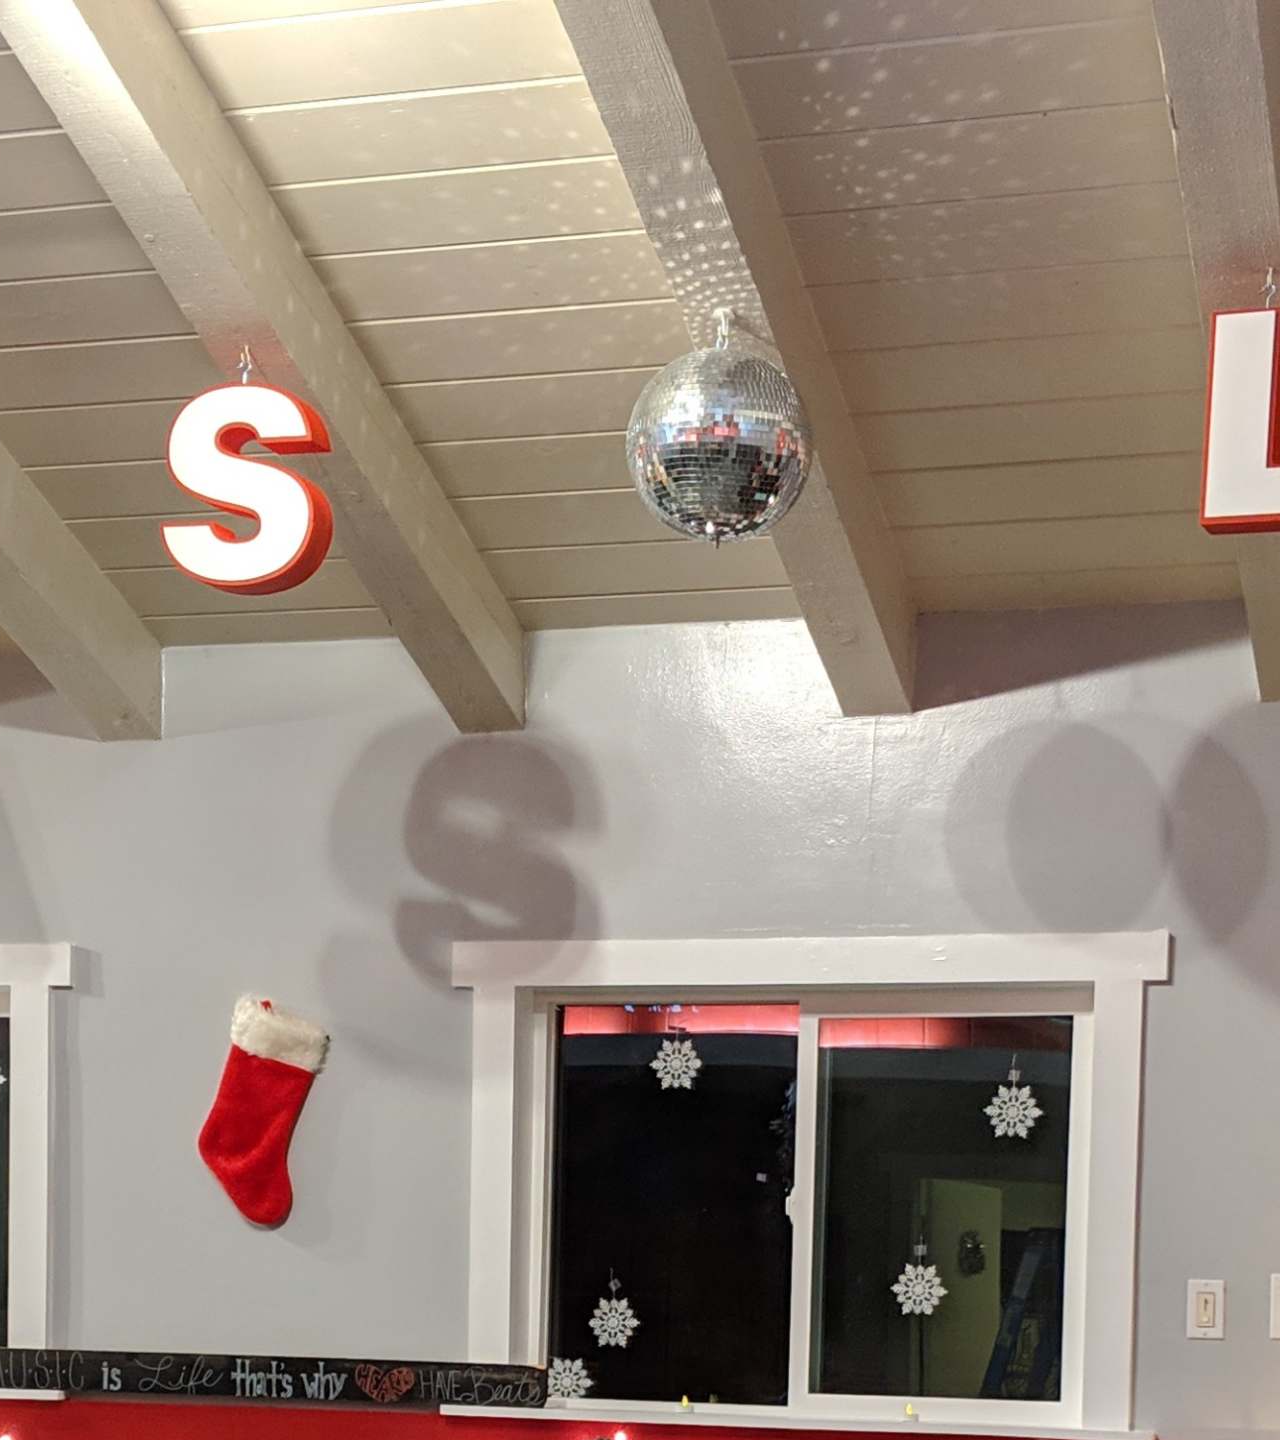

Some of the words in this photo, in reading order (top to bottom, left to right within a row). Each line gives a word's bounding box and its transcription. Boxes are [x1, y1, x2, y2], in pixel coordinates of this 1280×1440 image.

[101, 1361, 122, 1391] is
[133, 1355, 224, 1395] Life
[231, 1358, 293, 1398] that's
[300, 1362, 348, 1400] why
[420, 1368, 462, 1401] HAVE
